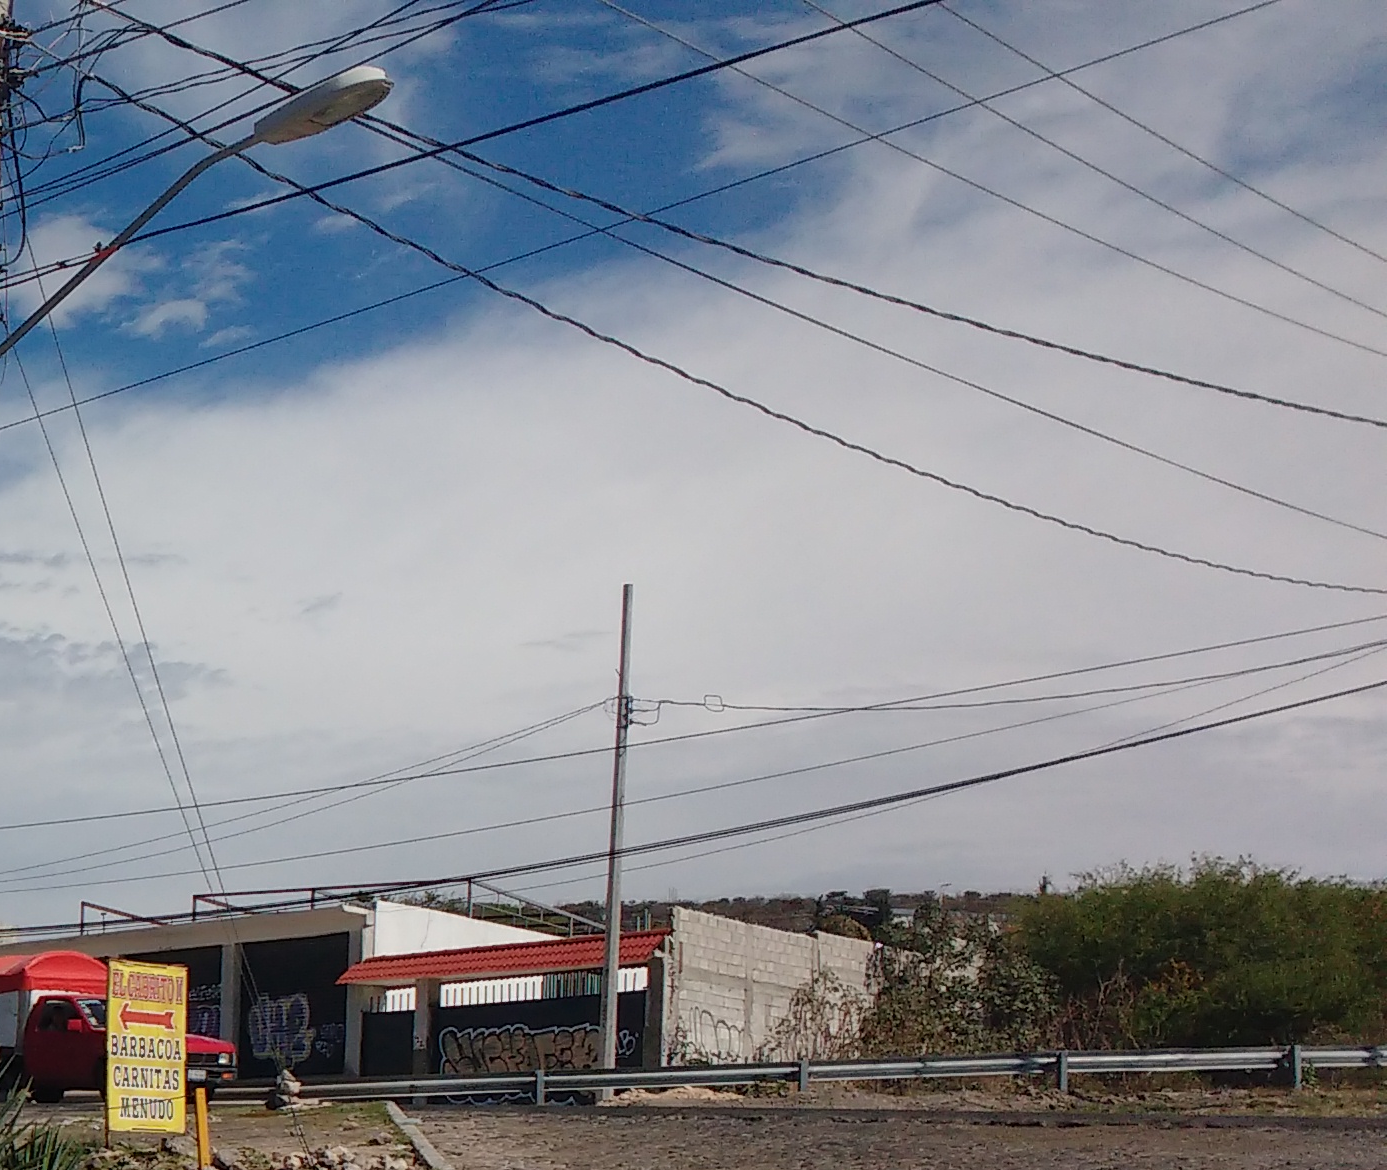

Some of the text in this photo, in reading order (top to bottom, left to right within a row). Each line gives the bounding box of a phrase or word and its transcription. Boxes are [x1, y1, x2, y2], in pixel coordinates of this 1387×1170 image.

[111, 1034, 182, 1060] BARBACOA
[113, 1065, 179, 1090] CARNITAS
[120, 1096, 173, 1120] MENUDO
